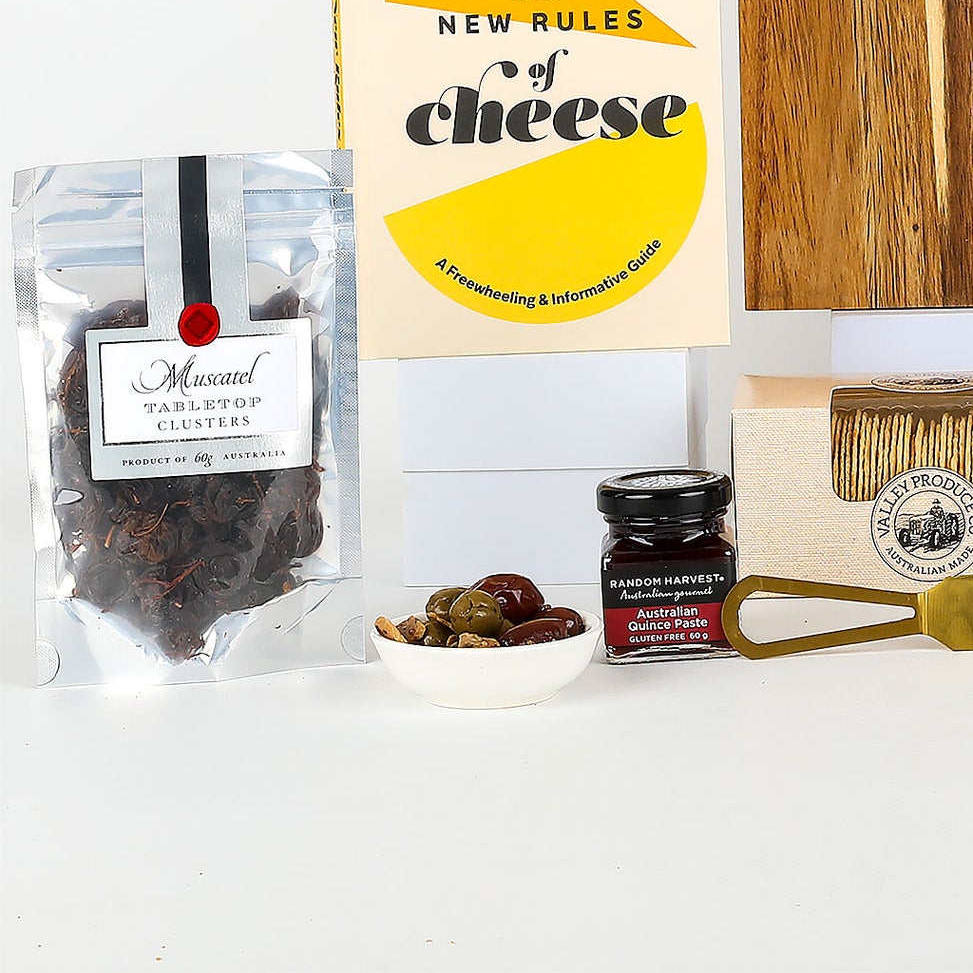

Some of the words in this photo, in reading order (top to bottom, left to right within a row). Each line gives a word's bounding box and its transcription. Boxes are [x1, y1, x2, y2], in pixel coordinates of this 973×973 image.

[438, 13, 512, 35] NEW
[532, 9, 643, 32] RULES
[528, 48, 569, 92] of
[406, 60, 687, 145] cheese
[435, 258, 448, 272] A
[445, 265, 537, 309] Freewheeling
[538, 294, 549, 306] &
[551, 268, 629, 306] Informative
[626, 238, 662, 273] Guide
[131, 351, 271, 397] Muscatel
[143, 396, 262, 414] TABLETOP
[157, 415, 250, 431] CLUSTERS
[122, 457, 170, 467] PRODUCT
[194, 451, 213, 467] 60g
[222, 450, 286, 461] AUSTRALIA
[877, 480, 910, 539] VALLEY
[885, 547, 946, 575] AUSTRALIAN
[948, 545, 973, 571] MADE
[610, 577, 661, 589] RANDOM
[619, 587, 673, 600] Australian
[636, 606, 699, 619] Australian
[628, 620, 671, 631] Quince
[674, 617, 708, 629] Paste
[629, 634, 662, 643] GLUTEN
[664, 633, 686, 641] FREE
